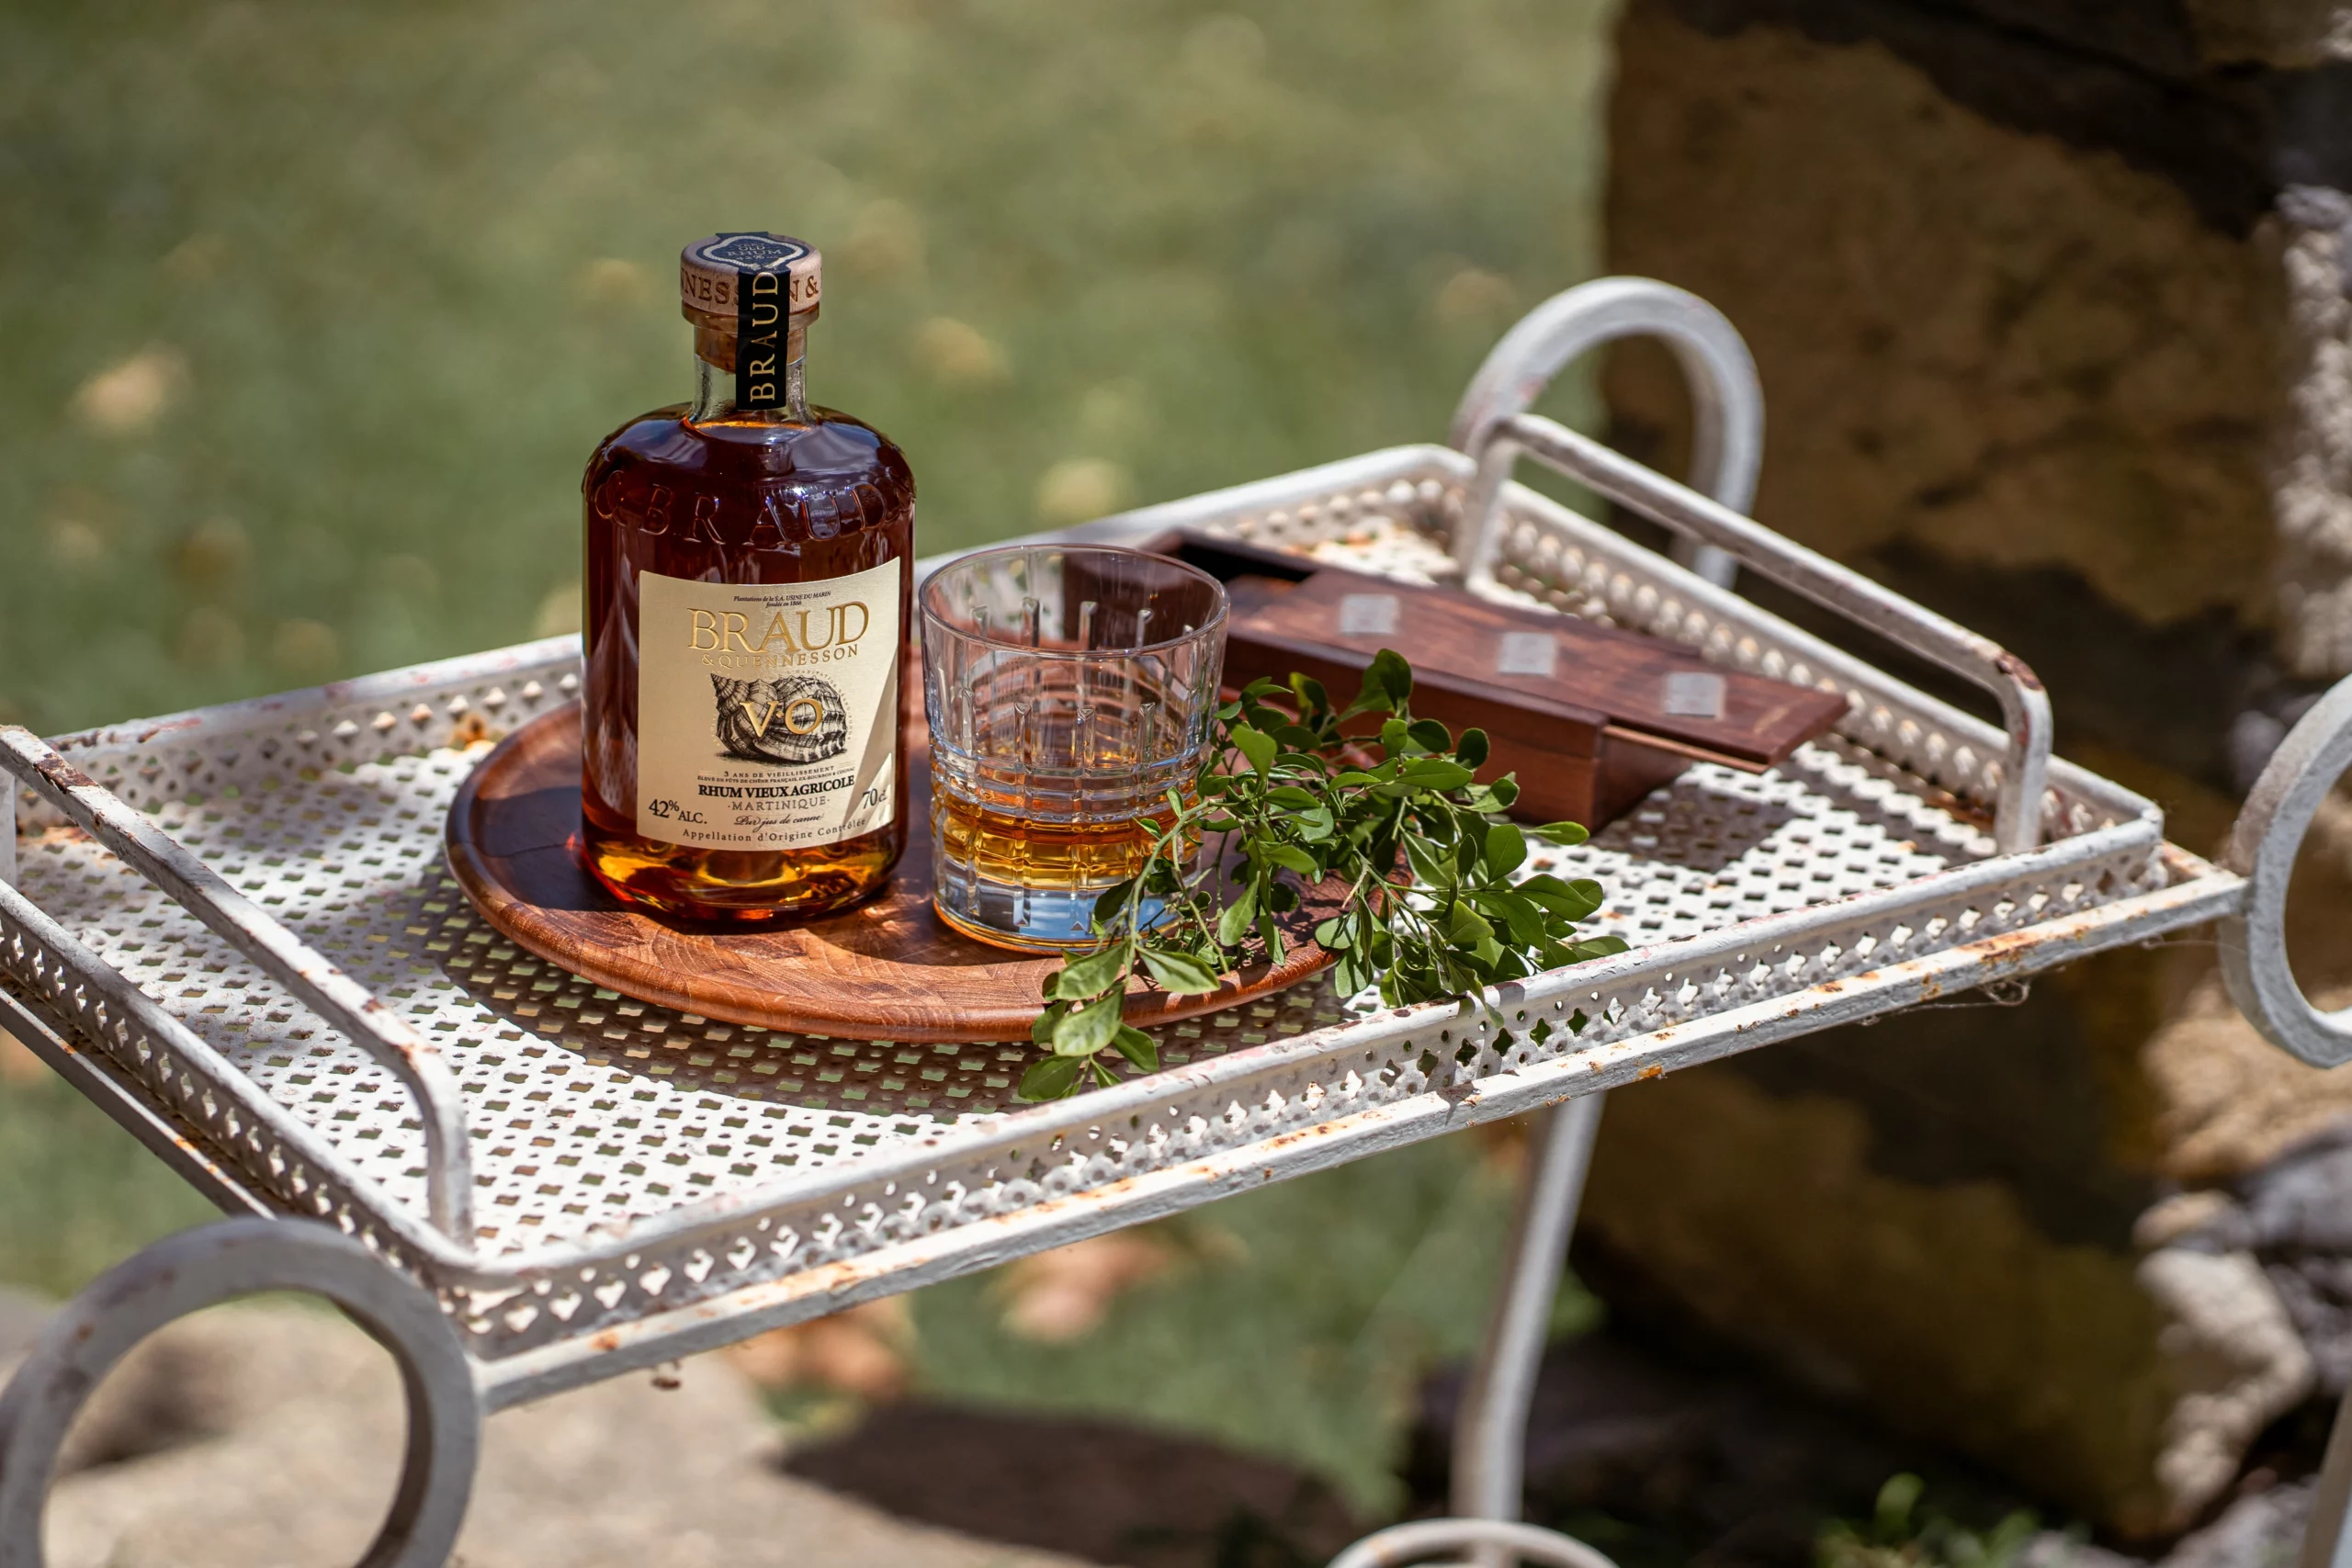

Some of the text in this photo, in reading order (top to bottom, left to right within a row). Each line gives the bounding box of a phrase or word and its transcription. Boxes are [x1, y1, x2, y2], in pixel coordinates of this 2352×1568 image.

[727, 249, 783, 257] RHUM
[805, 276, 819, 299] &
[750, 272, 779, 403] BRAUD
[639, 482, 887, 546] BRAUD
[813, 591, 831, 599] MARIN
[686, 601, 869, 654] BRAUD
[701, 644, 858, 670] & QUENNESSON
[767, 765, 834, 778] VIEILLISSEMENT
[697, 775, 855, 798] RHUM VIEUX AGRICOLE
[649, 798, 707, 825] 42% ALC.
[733, 813, 825, 833] Pur jus de canne
[683, 818, 865, 841] Appellation d'Origine Contrôlée
